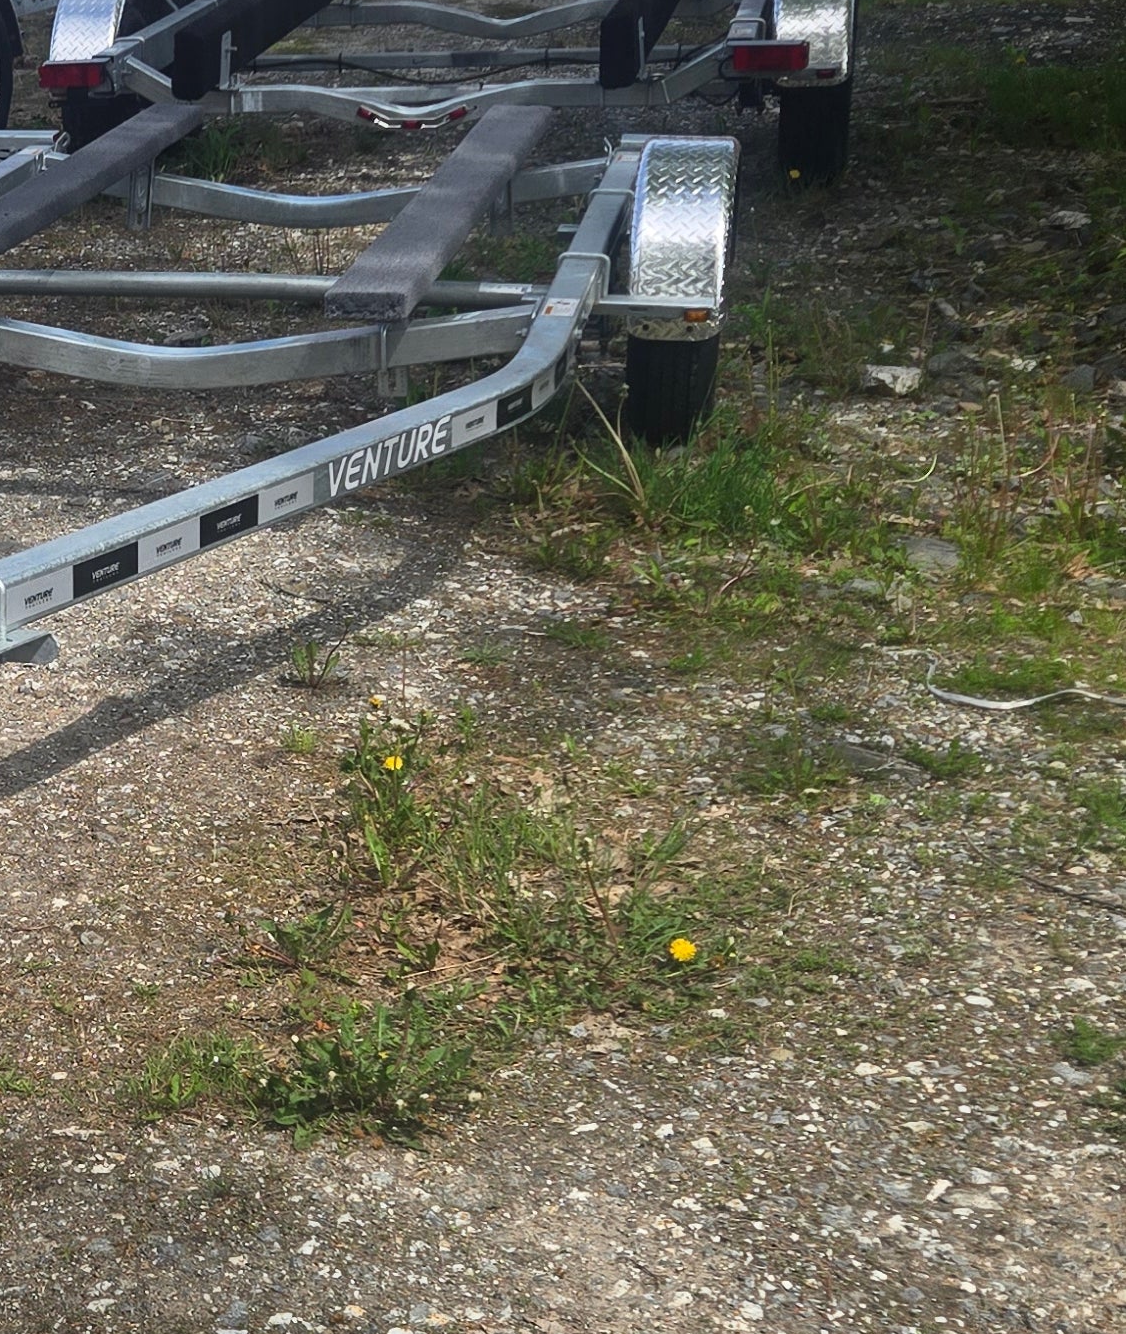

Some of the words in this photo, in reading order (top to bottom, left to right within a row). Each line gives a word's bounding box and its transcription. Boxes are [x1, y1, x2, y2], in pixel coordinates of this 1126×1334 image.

[328, 415, 451, 497] VENTURE
[91, 562, 120, 580] VENTURE
[24, 587, 54, 605] VENTURE
